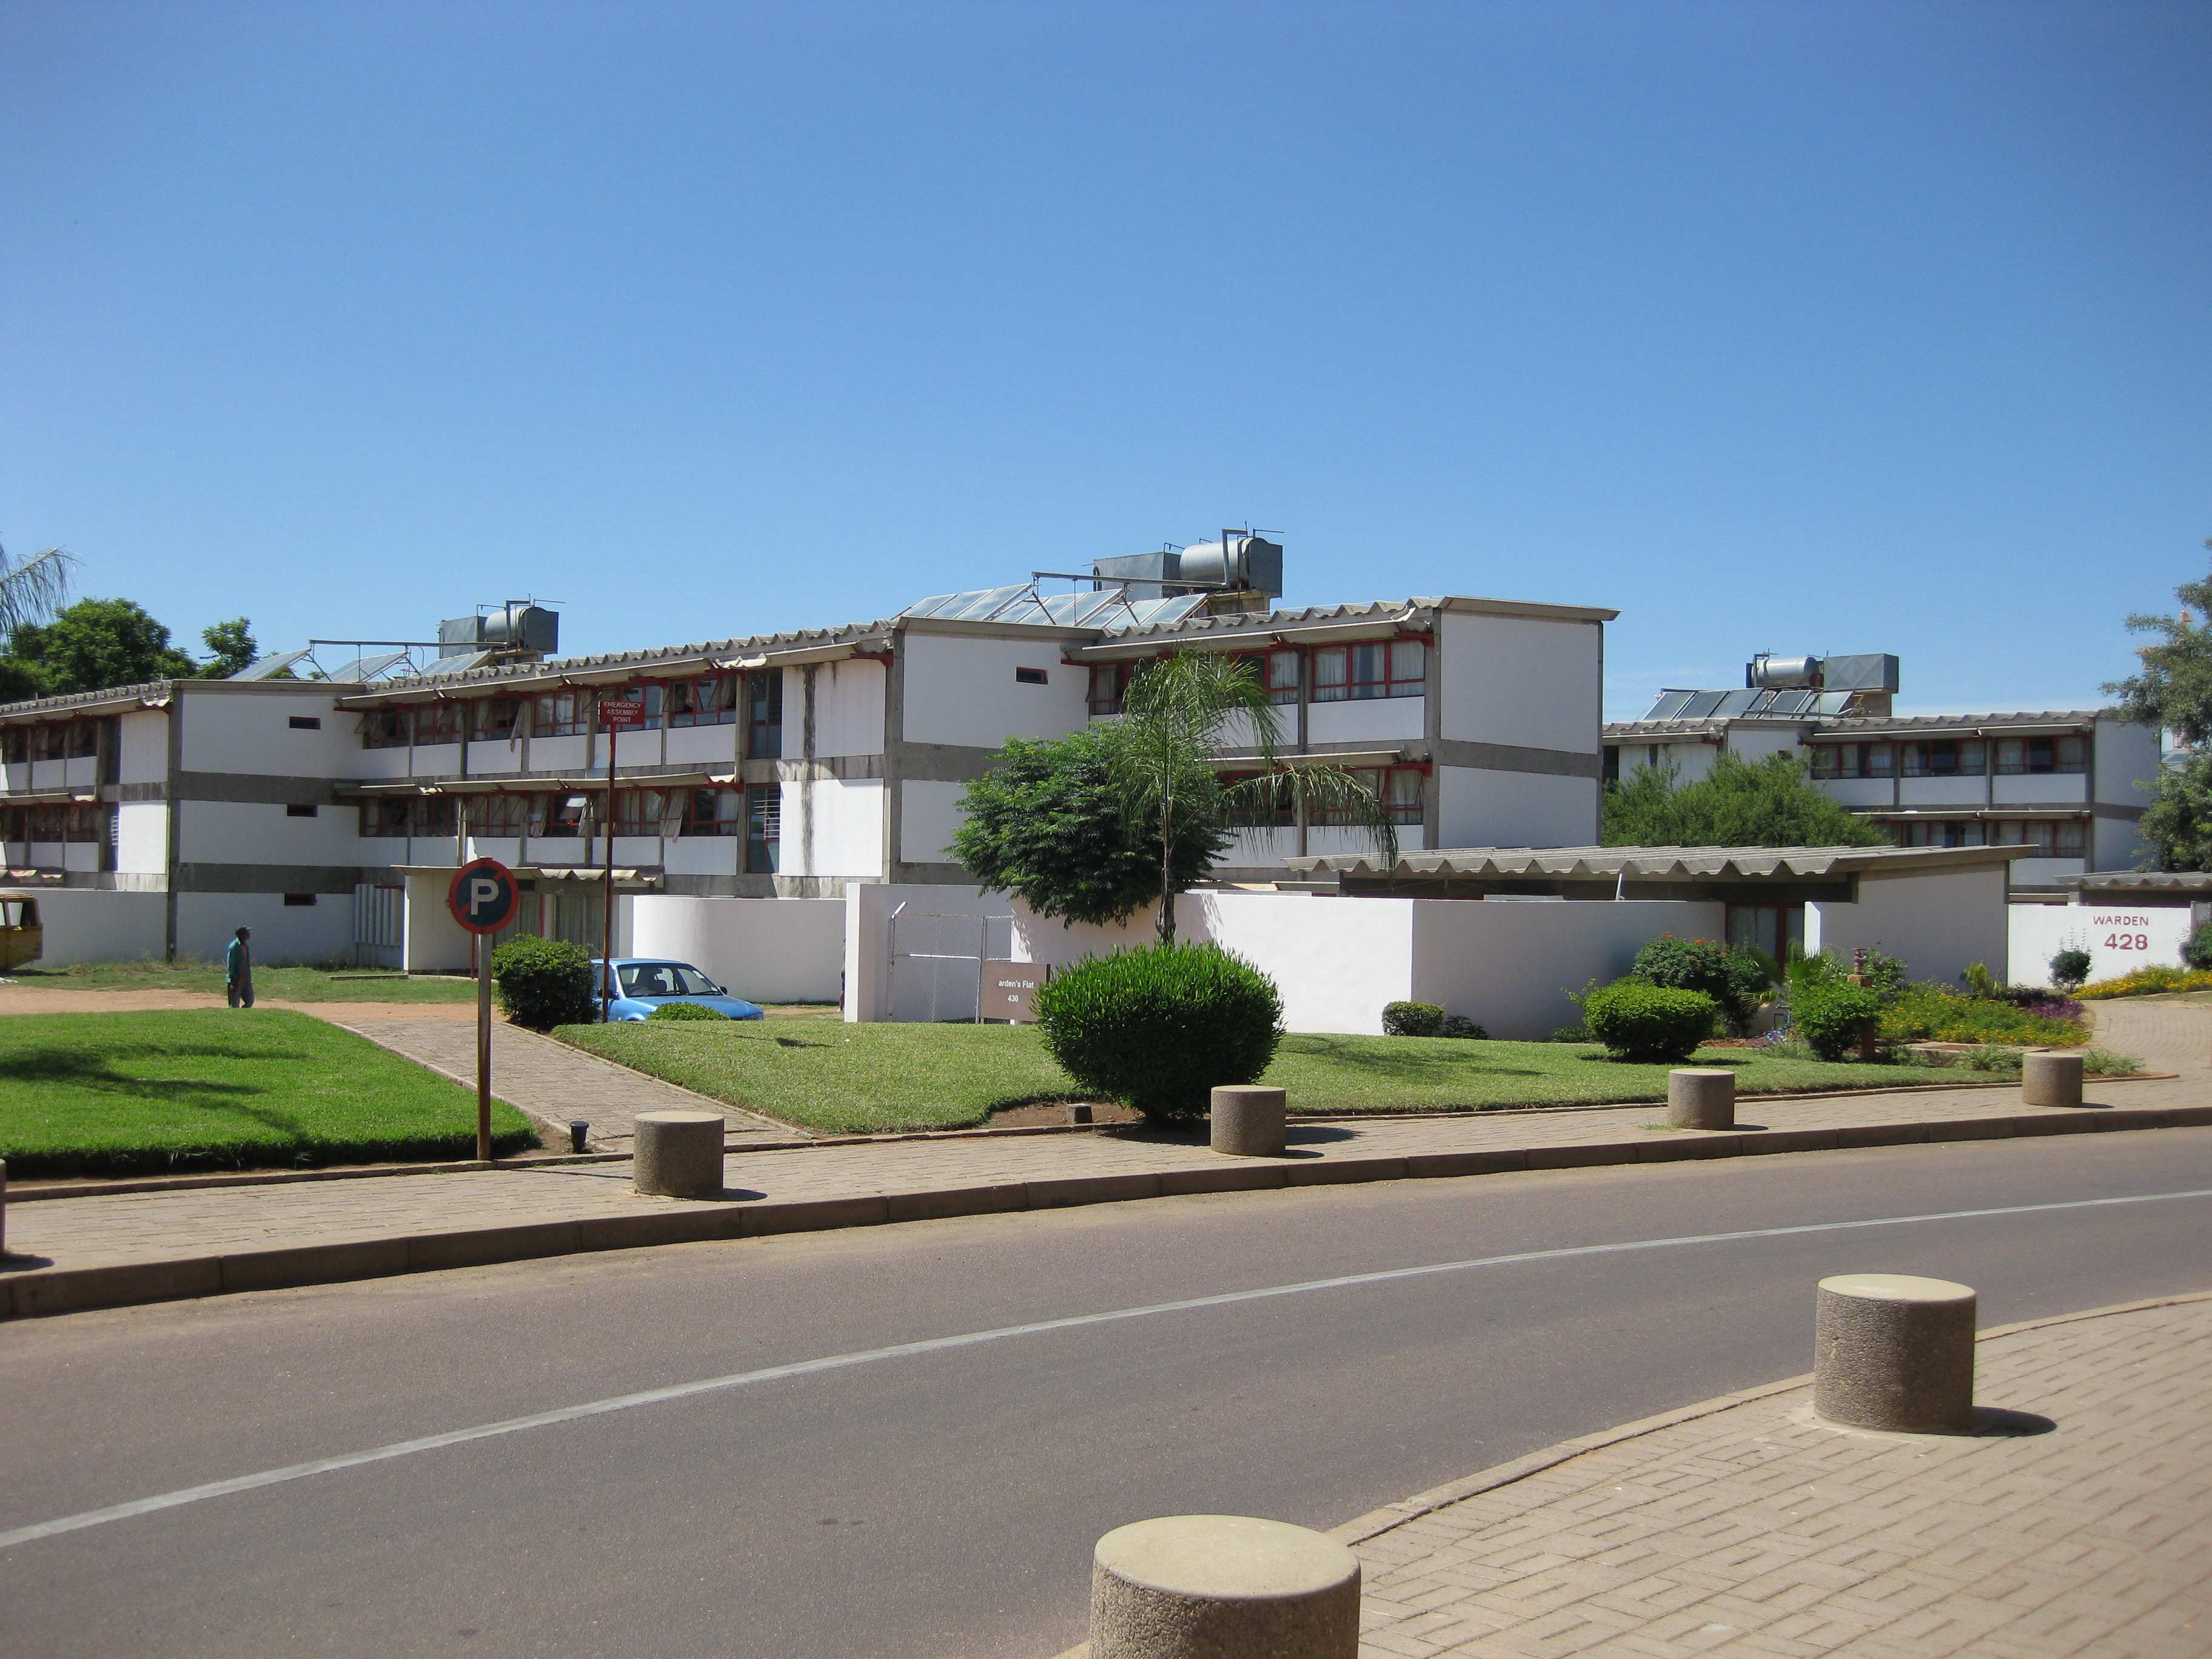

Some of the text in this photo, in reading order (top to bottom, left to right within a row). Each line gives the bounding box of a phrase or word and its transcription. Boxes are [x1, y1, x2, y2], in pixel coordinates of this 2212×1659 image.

[471, 878, 499, 915] P
[2093, 916, 2149, 926] WARDEN
[2104, 933, 2148, 951] 428
